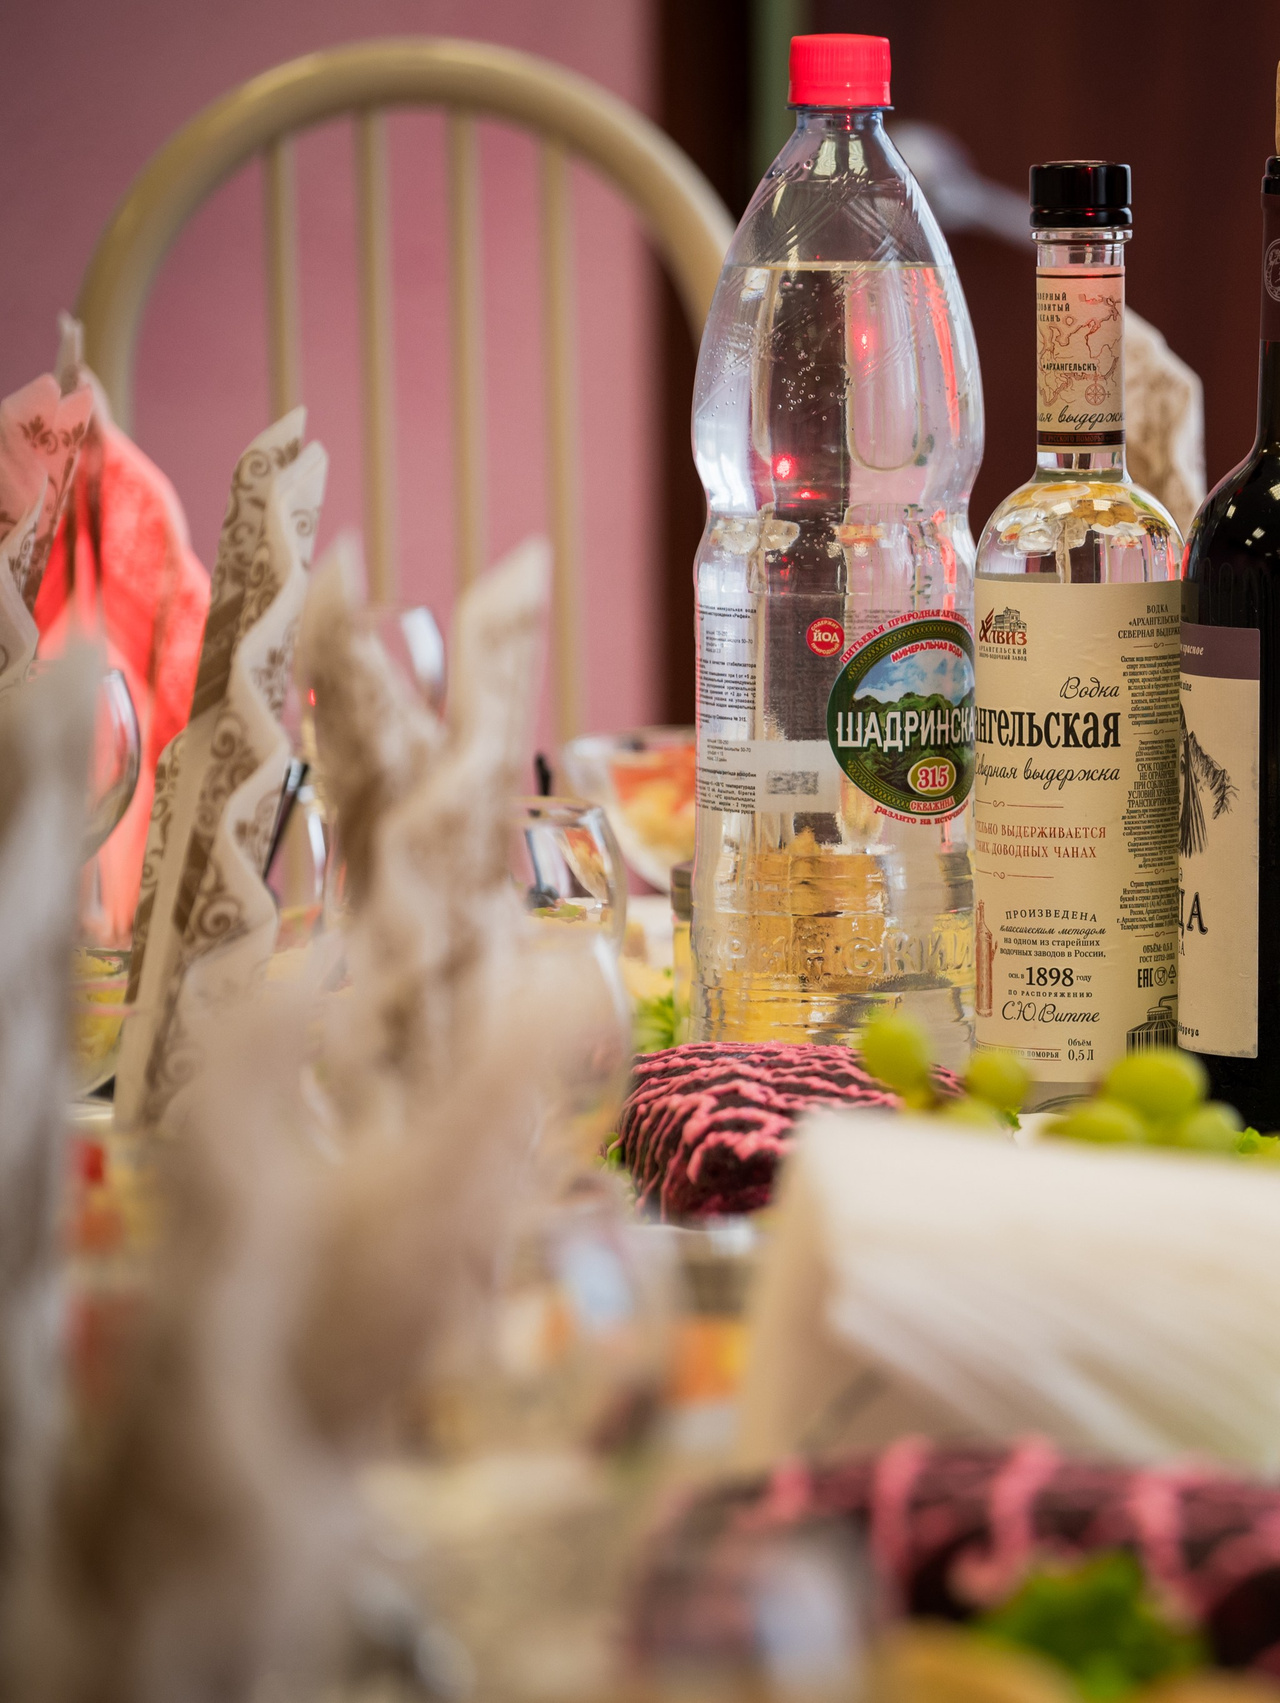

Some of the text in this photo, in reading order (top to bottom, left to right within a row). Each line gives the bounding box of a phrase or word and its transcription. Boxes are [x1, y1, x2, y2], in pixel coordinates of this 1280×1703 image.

[1046, 362, 1097, 371] АРХАНГЕЛЬСКЪ
[1146, 604, 1169, 614] ВОДКА
[813, 629, 840, 643] ЙОД
[841, 625, 885, 663] ПИТЬЕВАЯ
[888, 609, 941, 629] ПРИРОДНАЯ
[1117, 629, 1155, 639] СЕВЕРНАЯ
[891, 640, 963, 663] МИНЕРАЛЬНАЯ ВОДА
[1059, 676, 1120, 699] Водка
[918, 766, 948, 789] 315
[1023, 757, 1120, 791] выдержка
[910, 797, 955, 811] СКВАЖИНА
[874, 805, 917, 824] разлито
[1001, 824, 1106, 839] ВЫДЕРЖИВАЕТСЯ
[992, 843, 1049, 858] ДОВОДНЫХ
[1053, 846, 1097, 858] ЧАНАХ
[1005, 909, 1097, 922] ПРОИЗВЕДЕНА
[1000, 925, 1106, 939] классическим методом
[1014, 938, 1037, 946] одном
[1051, 939, 1100, 948] старейших
[1000, 948, 1032, 957] водочных
[1025, 966, 1074, 987] 1898
[1021, 990, 1093, 998] РАСПОРЯЖЕНИЮ
[1038, 1003, 1100, 1023] Витте
[1067, 1038, 1092, 1047] Объём
[1027, 1050, 1059, 1058] ПОМОРЬЯ
